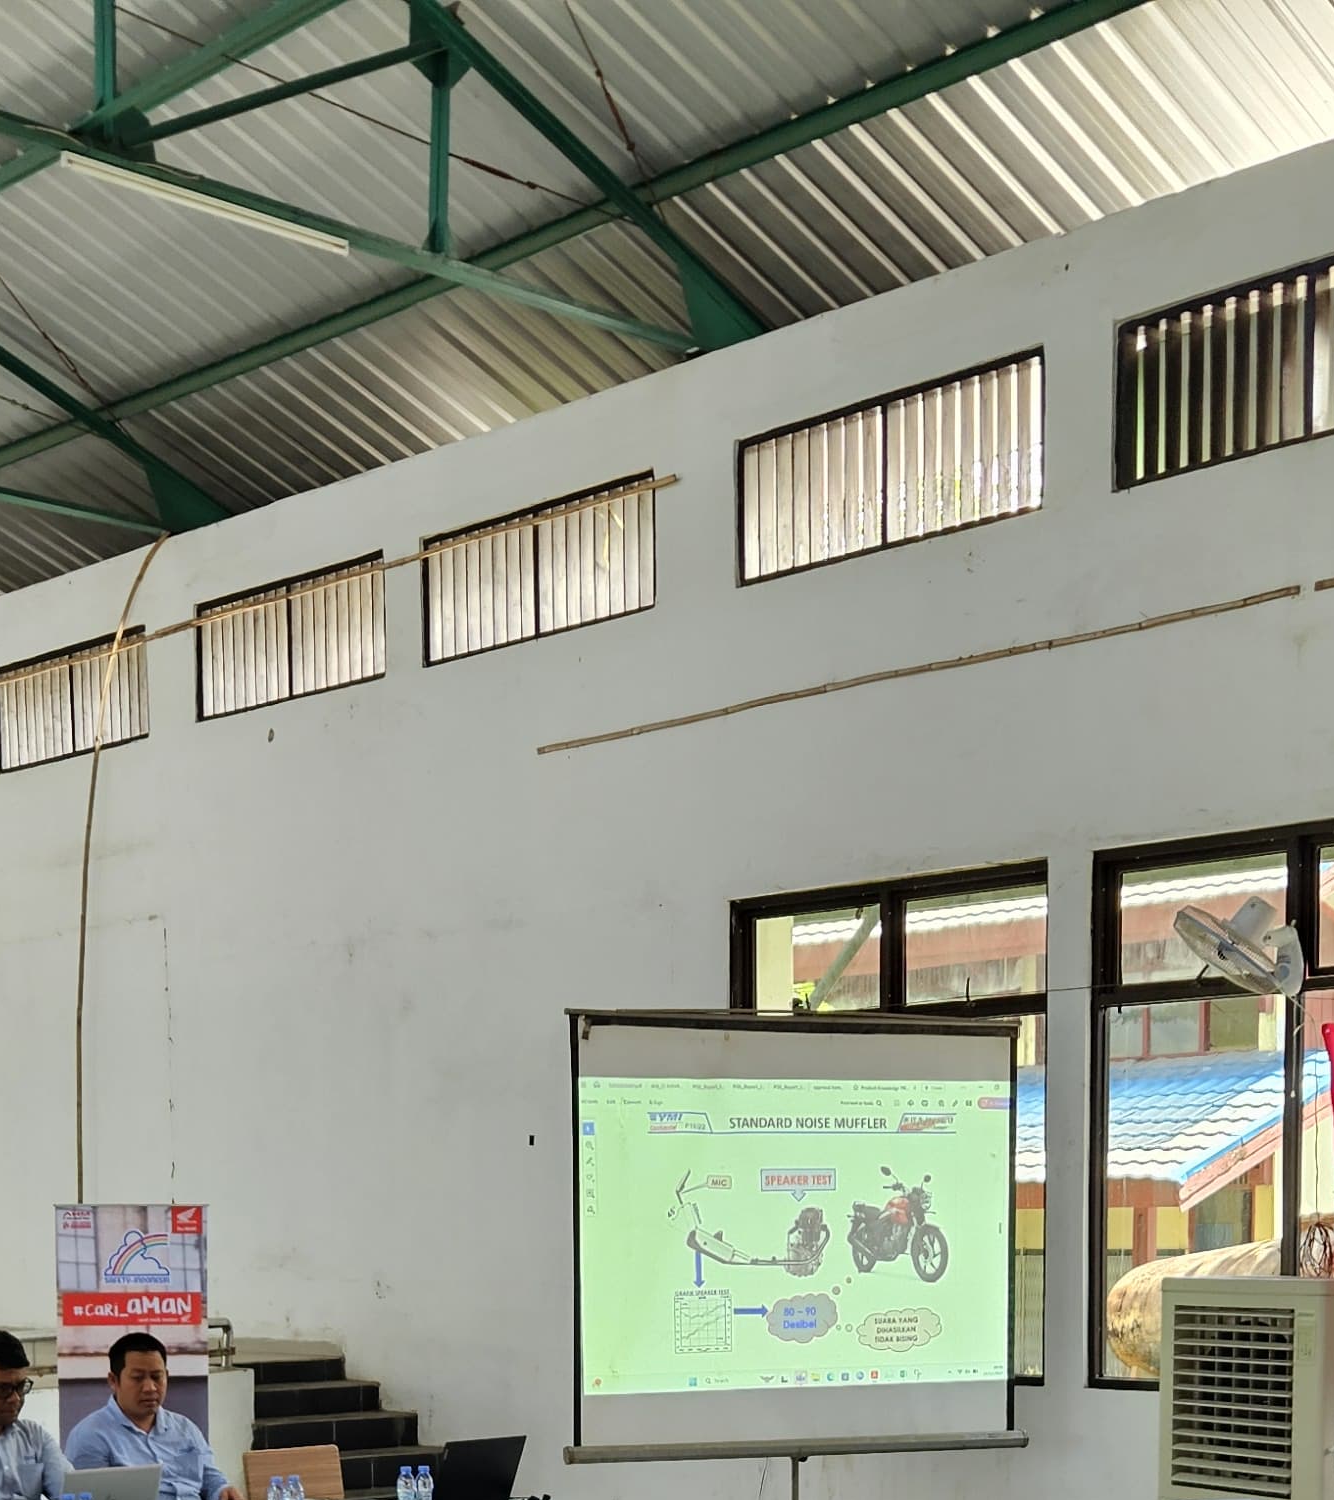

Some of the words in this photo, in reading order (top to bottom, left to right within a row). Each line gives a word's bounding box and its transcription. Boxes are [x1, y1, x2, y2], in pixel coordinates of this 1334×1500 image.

[729, 1117, 792, 1129] STANDARD
[796, 1117, 831, 1129] NOISE
[834, 1117, 887, 1129] MUFFLER
[765, 1175, 809, 1186] SPEAKER
[811, 1175, 832, 1186] TEST
[899, 1316, 918, 1324] YANG
[783, 1320, 817, 1329] Desibel
[877, 1326, 916, 1334] DIHASILKAN
[896, 1335, 918, 1343] BISING
